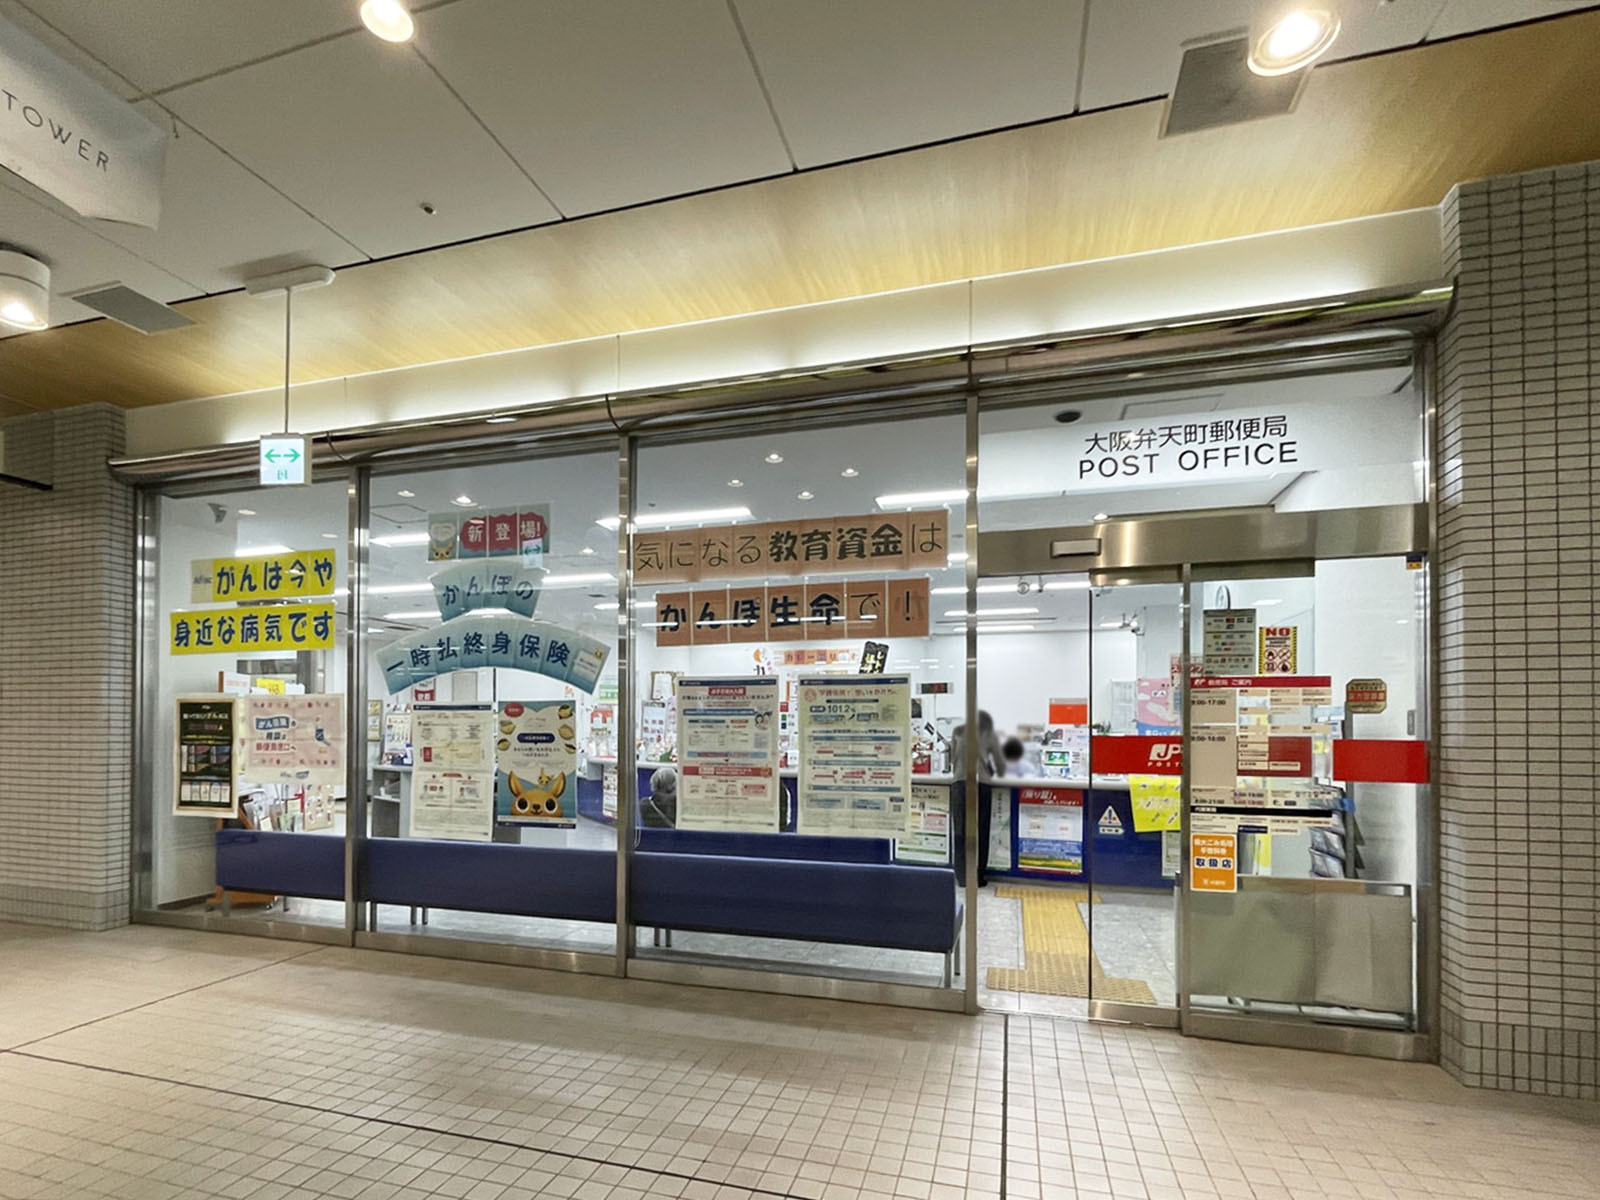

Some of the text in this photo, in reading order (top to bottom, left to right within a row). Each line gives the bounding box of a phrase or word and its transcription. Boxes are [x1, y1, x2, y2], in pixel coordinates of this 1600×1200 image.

[2, 89, 109, 172] TOWER
[1085, 415, 1287, 454] 大阪弁天町郵便局
[1079, 441, 1298, 479] POST OFFICE
[635, 522, 943, 571] 気になる教育資金は
[217, 558, 332, 595] がんは今や
[442, 575, 534, 605] かんぽの
[174, 611, 333, 647] 身近な病気です
[1265, 627, 1290, 636] NO
[386, 631, 571, 672] 一時払終身保険
